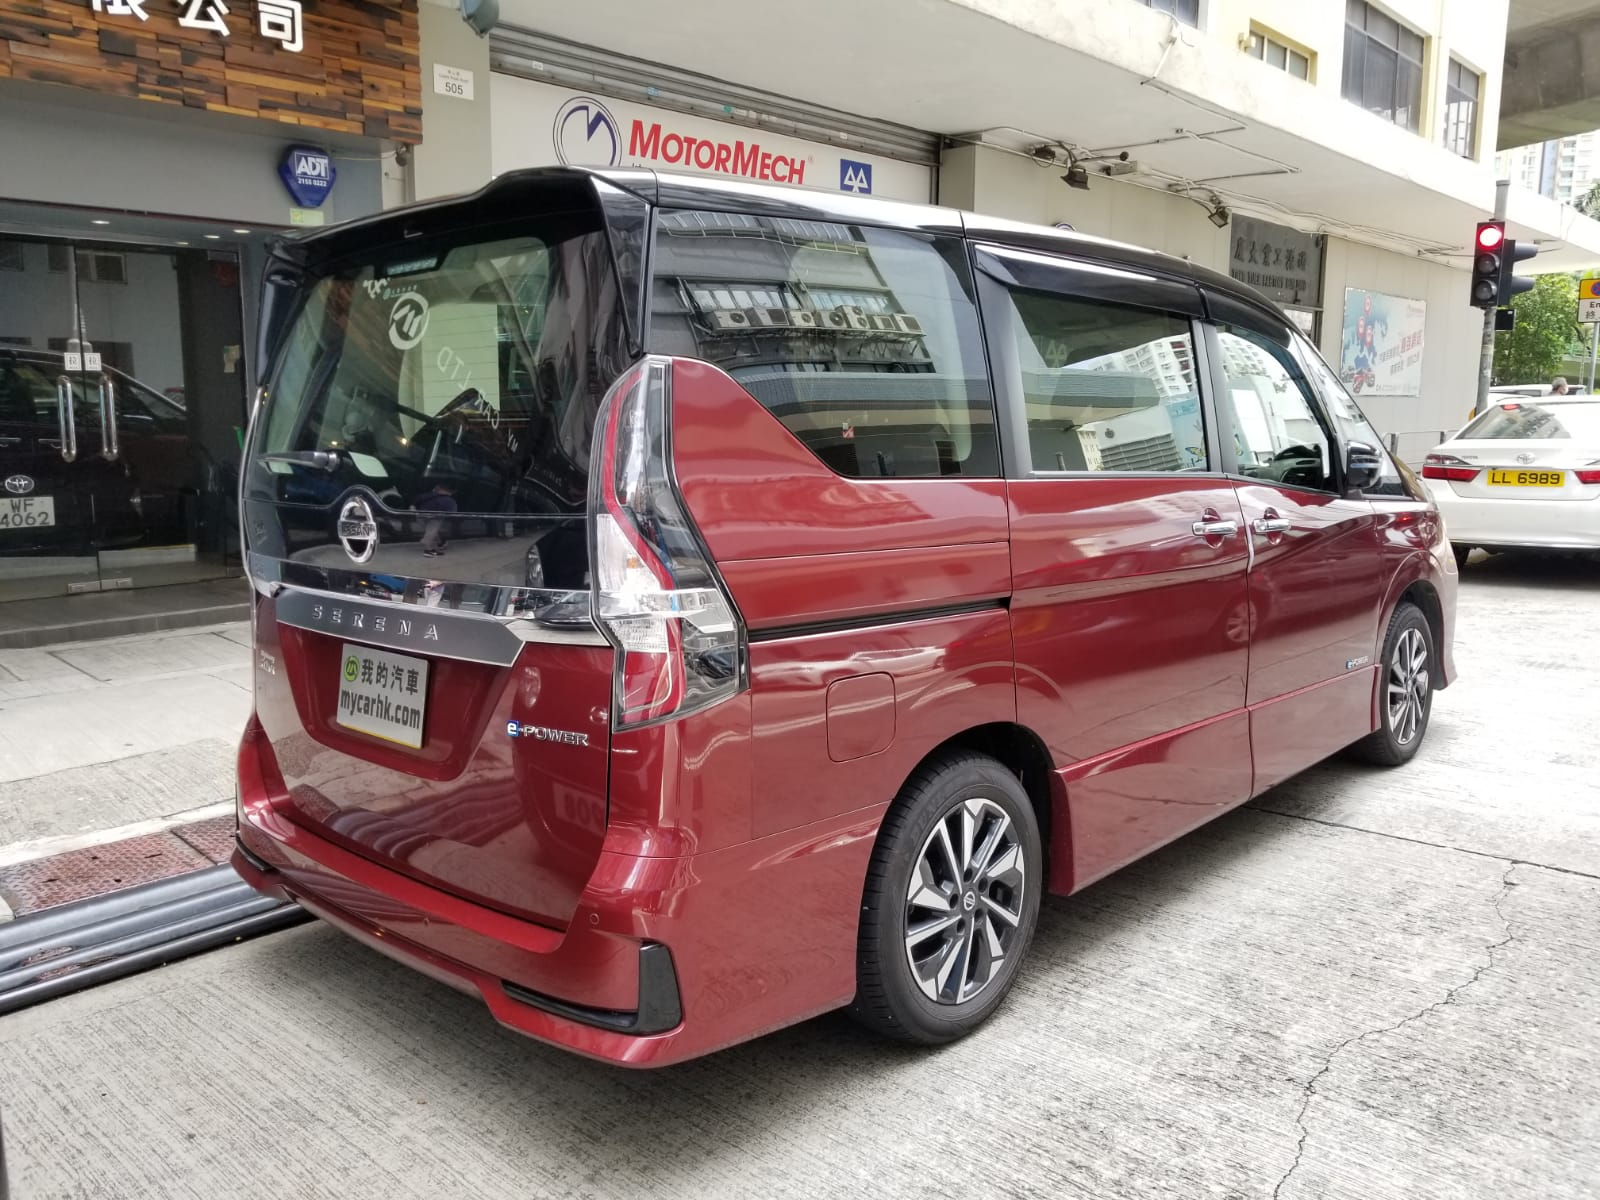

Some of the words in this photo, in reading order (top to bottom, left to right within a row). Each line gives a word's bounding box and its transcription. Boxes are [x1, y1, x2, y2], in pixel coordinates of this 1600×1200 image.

[445, 81, 464, 95] 505
[297, 156, 328, 177] ADT
[1491, 472, 1511, 484] LL
[1517, 472, 1561, 485] 6989
[10, 499, 35, 513] WF
[0, 511, 50, 527] 4062
[312, 604, 439, 641] SERENA
[361, 658, 419, 696] 我的汽車
[340, 689, 420, 730] mycarhk.com
[506, 721, 589, 747] e-POWER
